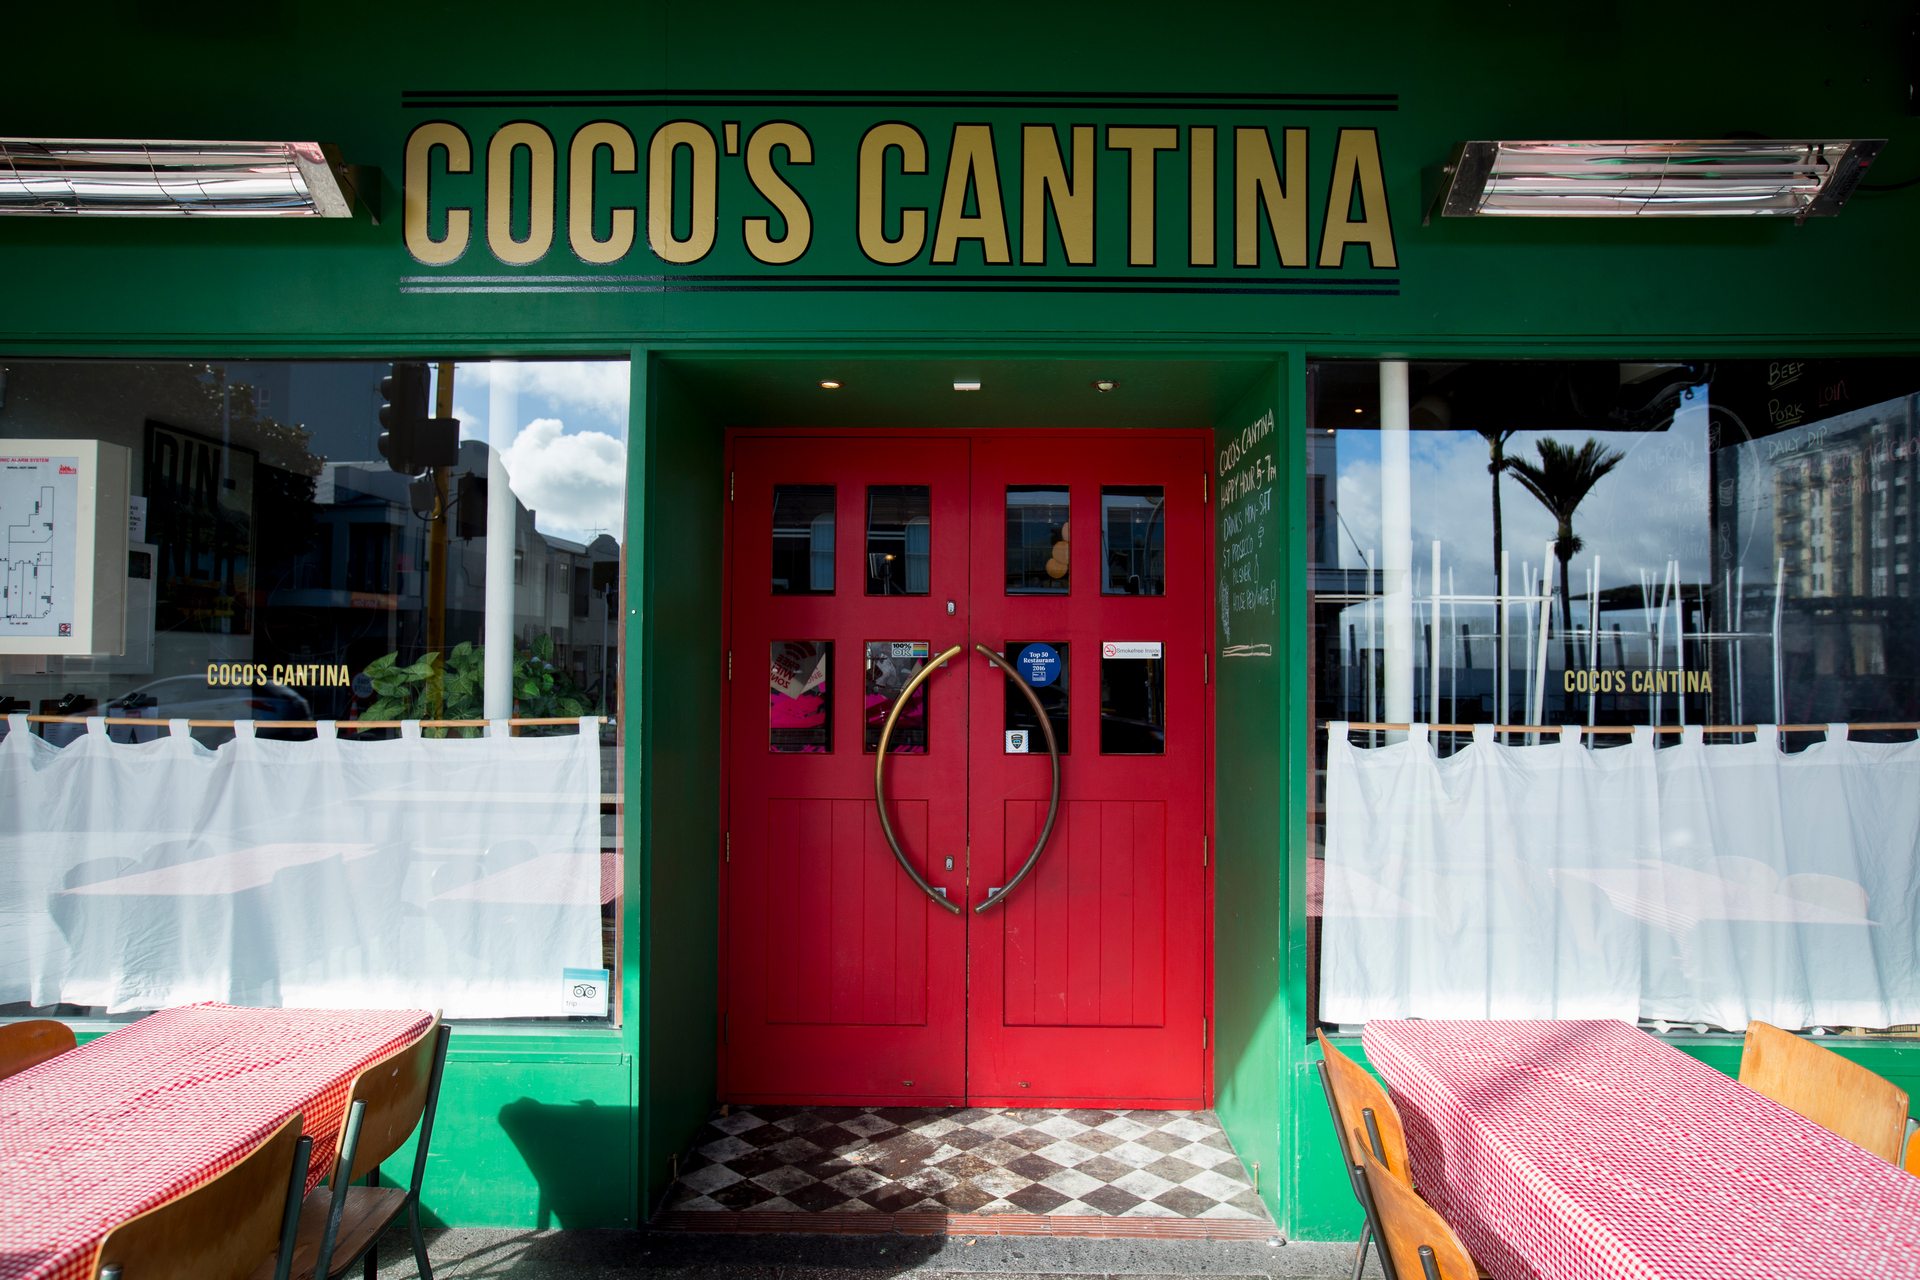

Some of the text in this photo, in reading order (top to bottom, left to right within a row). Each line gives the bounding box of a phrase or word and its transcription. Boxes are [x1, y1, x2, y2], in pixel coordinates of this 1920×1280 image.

[402, 119, 1399, 269] COCO'S CANTINA
[1768, 399, 1805, 423] PORK
[1241, 408, 1275, 455] CANTINA
[1768, 425, 1828, 460] DAILY DIP
[1220, 472, 1240, 510] HAPPY
[1240, 465, 1256, 499] HOUR
[207, 663, 350, 687] COCO'S CANTINA
[1564, 670, 1713, 693] COCO'S CANTINA
